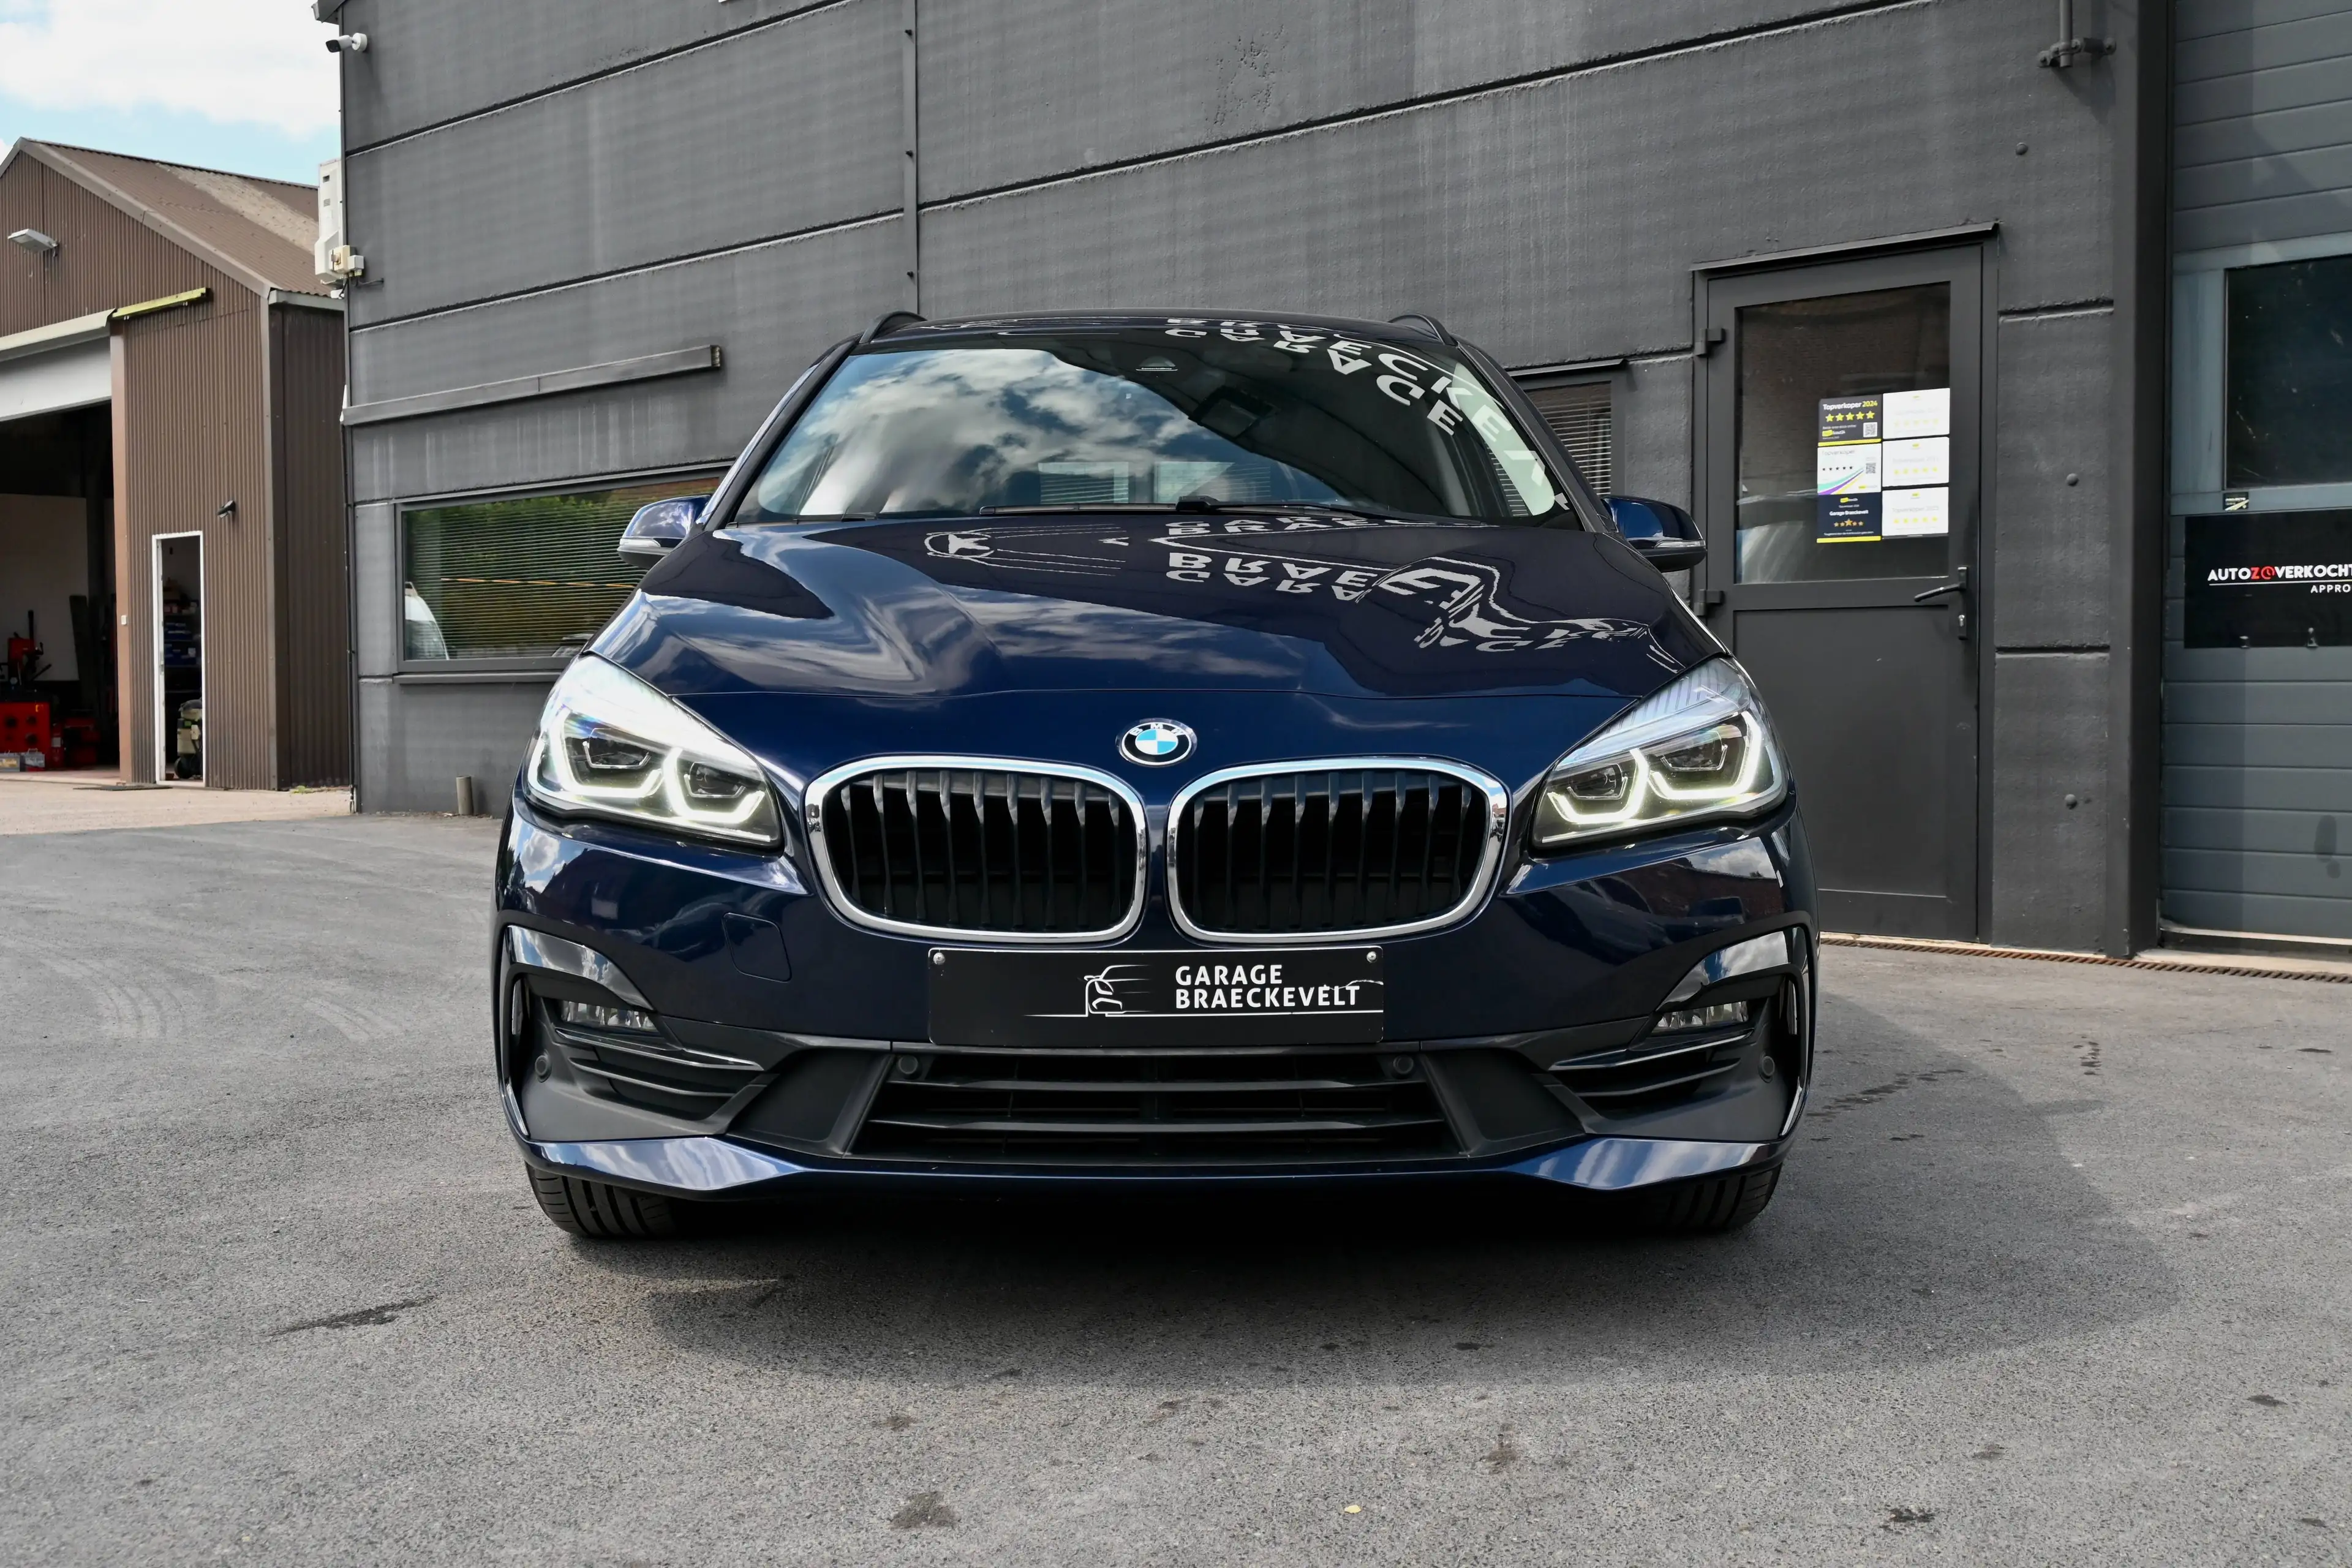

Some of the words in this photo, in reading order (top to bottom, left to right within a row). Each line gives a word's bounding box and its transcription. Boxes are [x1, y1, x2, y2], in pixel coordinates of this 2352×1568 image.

[1823, 402, 1862, 411] Topverkoper
[1175, 965, 1283, 986] GARAGE
[1175, 985, 1360, 1009] BRAECKEVELT
